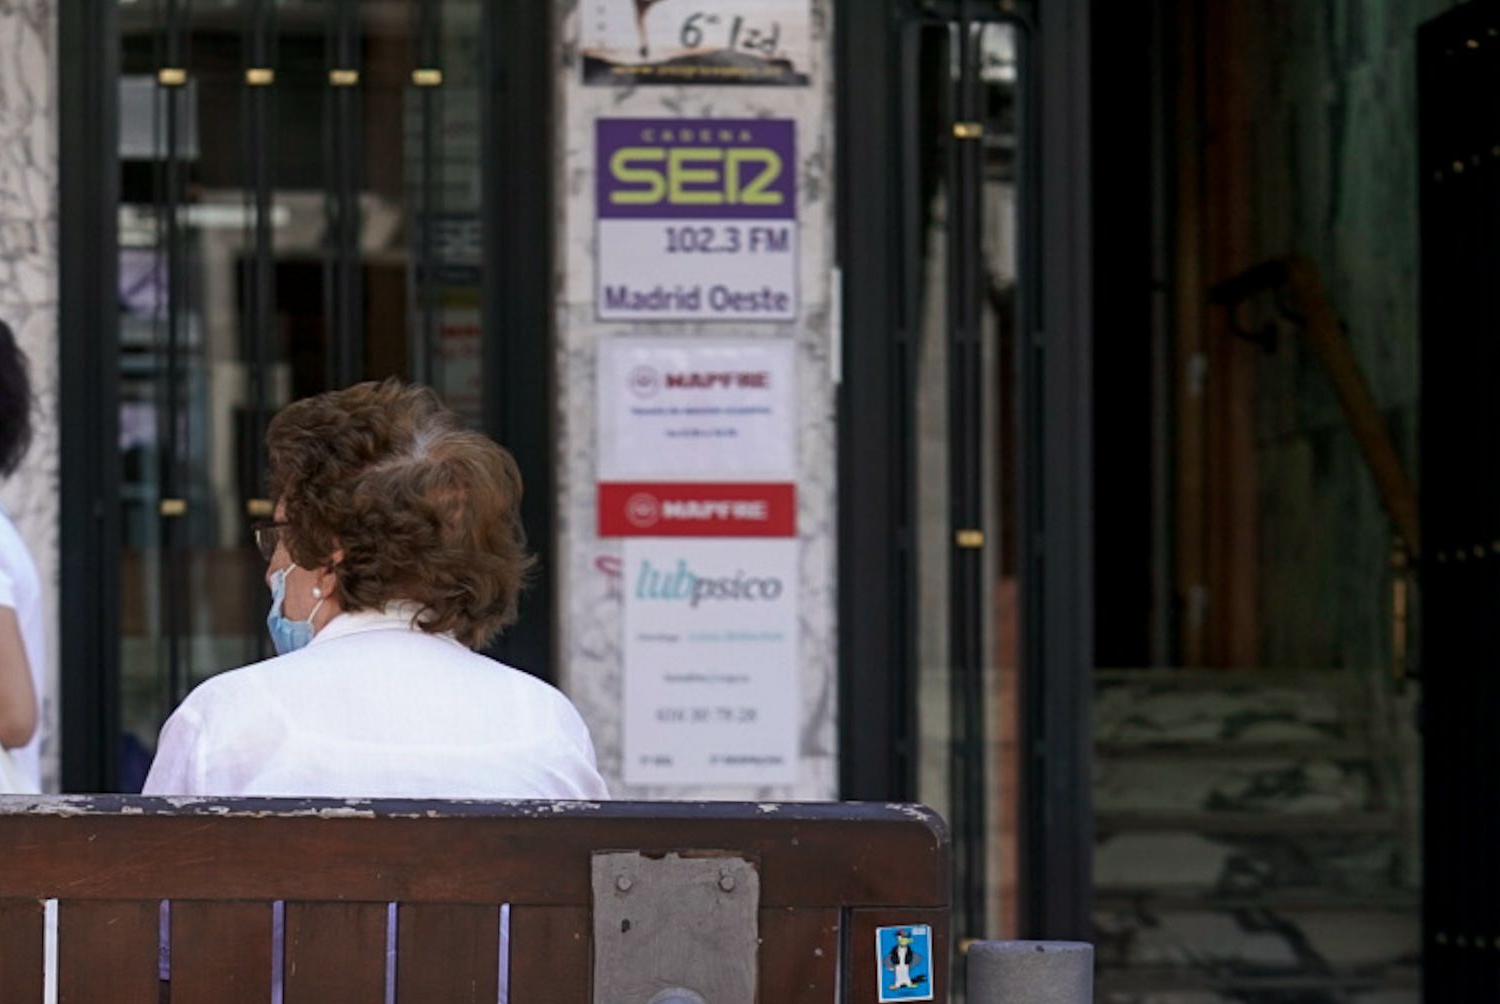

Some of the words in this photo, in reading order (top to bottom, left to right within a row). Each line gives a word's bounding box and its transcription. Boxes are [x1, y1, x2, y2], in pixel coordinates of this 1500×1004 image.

[641, 129, 753, 142] CADENA
[609, 147, 784, 205] SER
[665, 227, 741, 253] 102.3
[750, 228, 789, 252] FM
[604, 285, 701, 312] Madrid
[708, 285, 789, 312] Oeste
[665, 371, 769, 389] MAPFRE
[662, 500, 769, 520] MAPFRE
